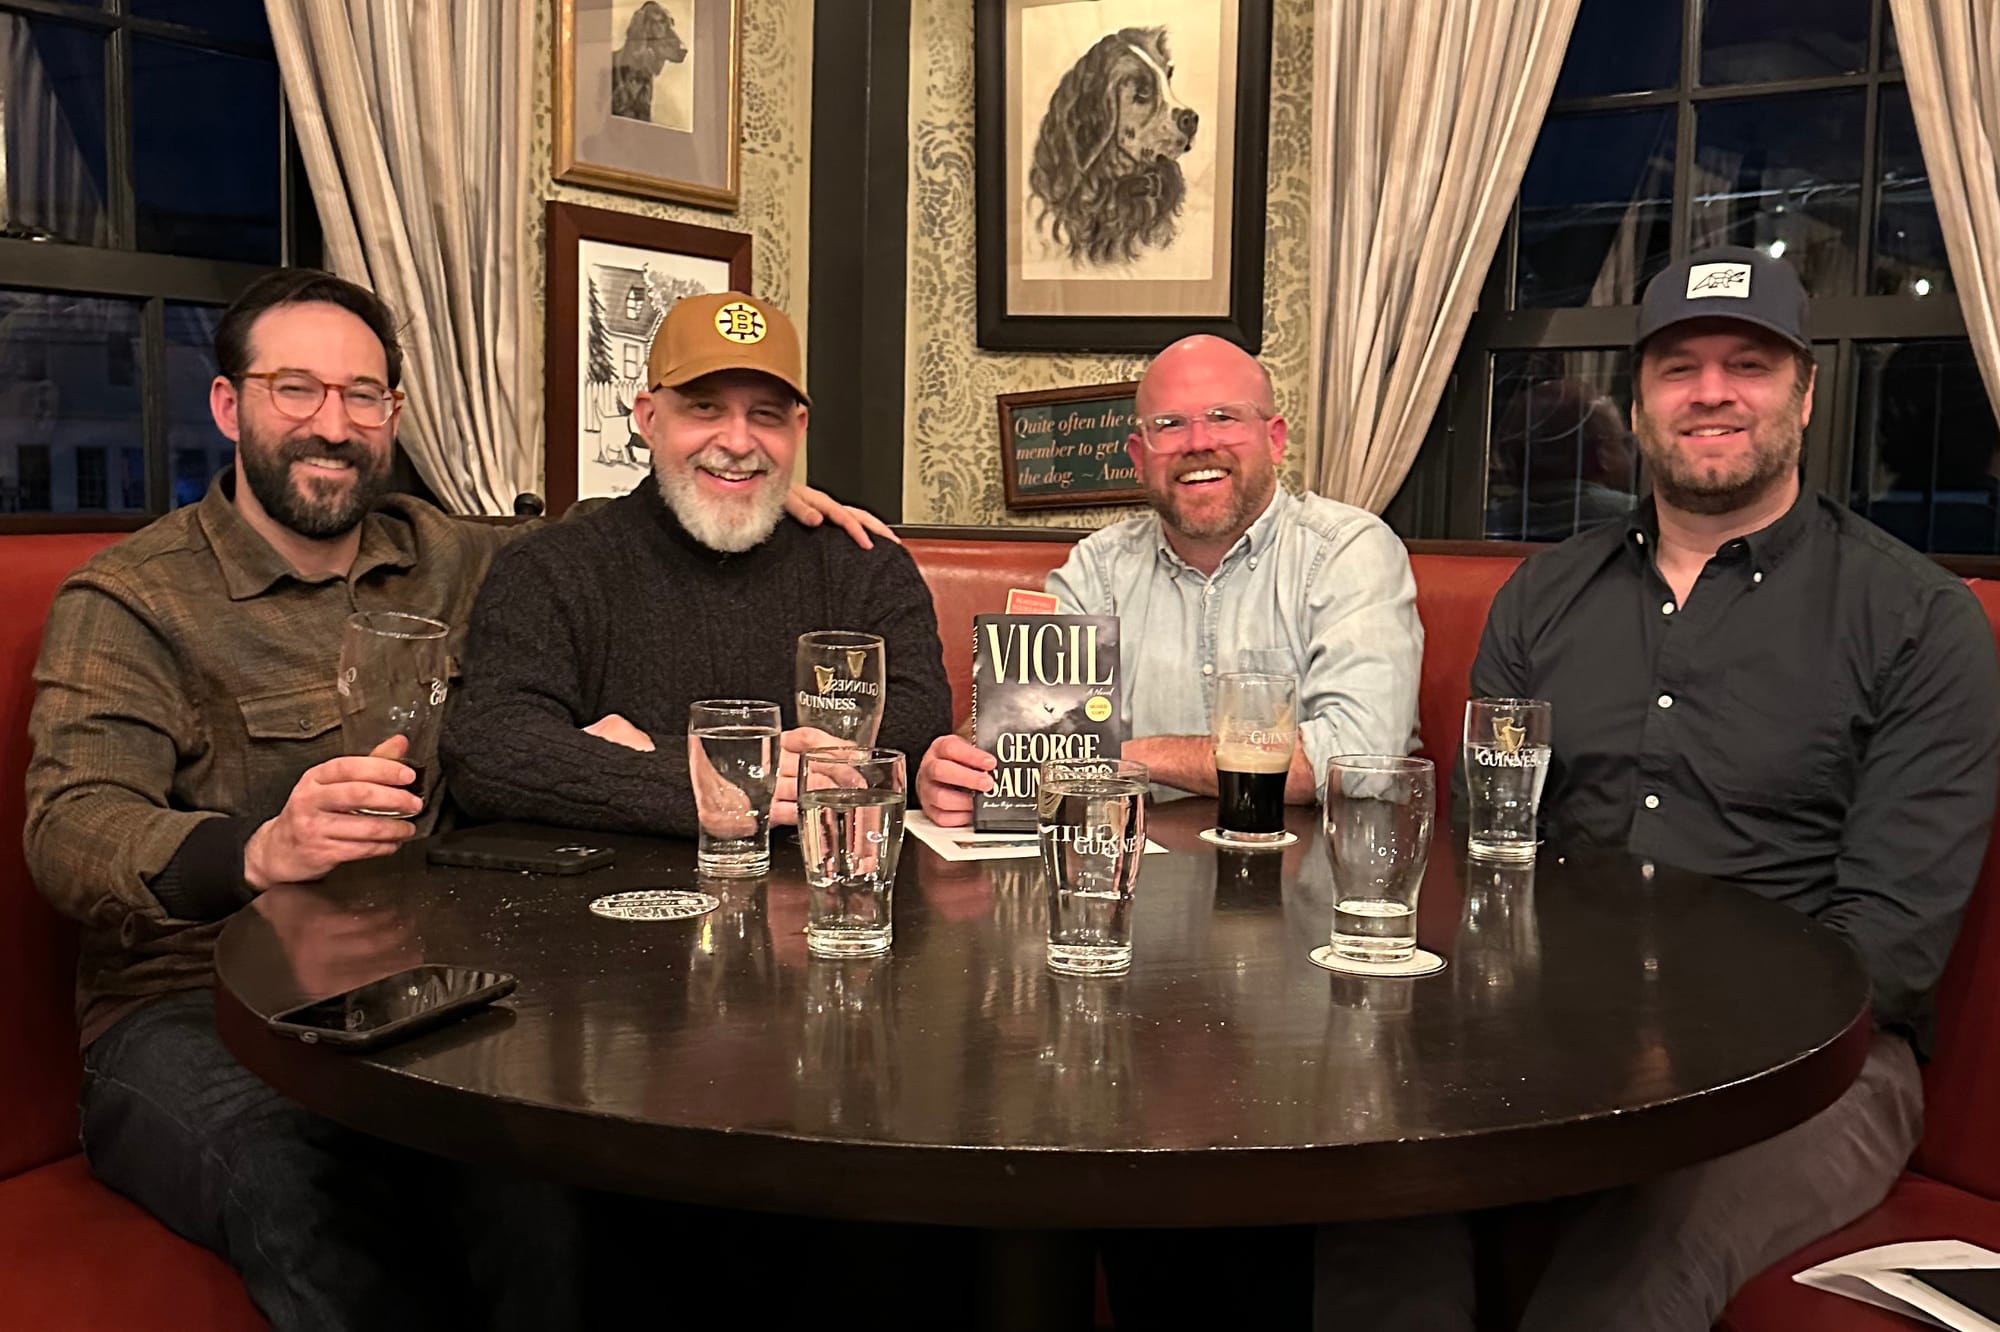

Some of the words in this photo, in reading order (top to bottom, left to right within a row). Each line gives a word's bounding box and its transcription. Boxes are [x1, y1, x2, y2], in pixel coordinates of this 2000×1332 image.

[731, 310, 754, 334] B
[1015, 416, 1055, 438] Quite
[1058, 412, 1096, 436] often
[1100, 408, 1124, 428] the
[1016, 440, 1075, 460] member
[1078, 442, 1093, 456] to
[1095, 440, 1119, 461] get
[1018, 467, 1041, 485] the
[986, 623, 1114, 686] VIGIL
[800, 690, 857, 710] GUINNESS
[996, 732, 1101, 764] GEORGE
